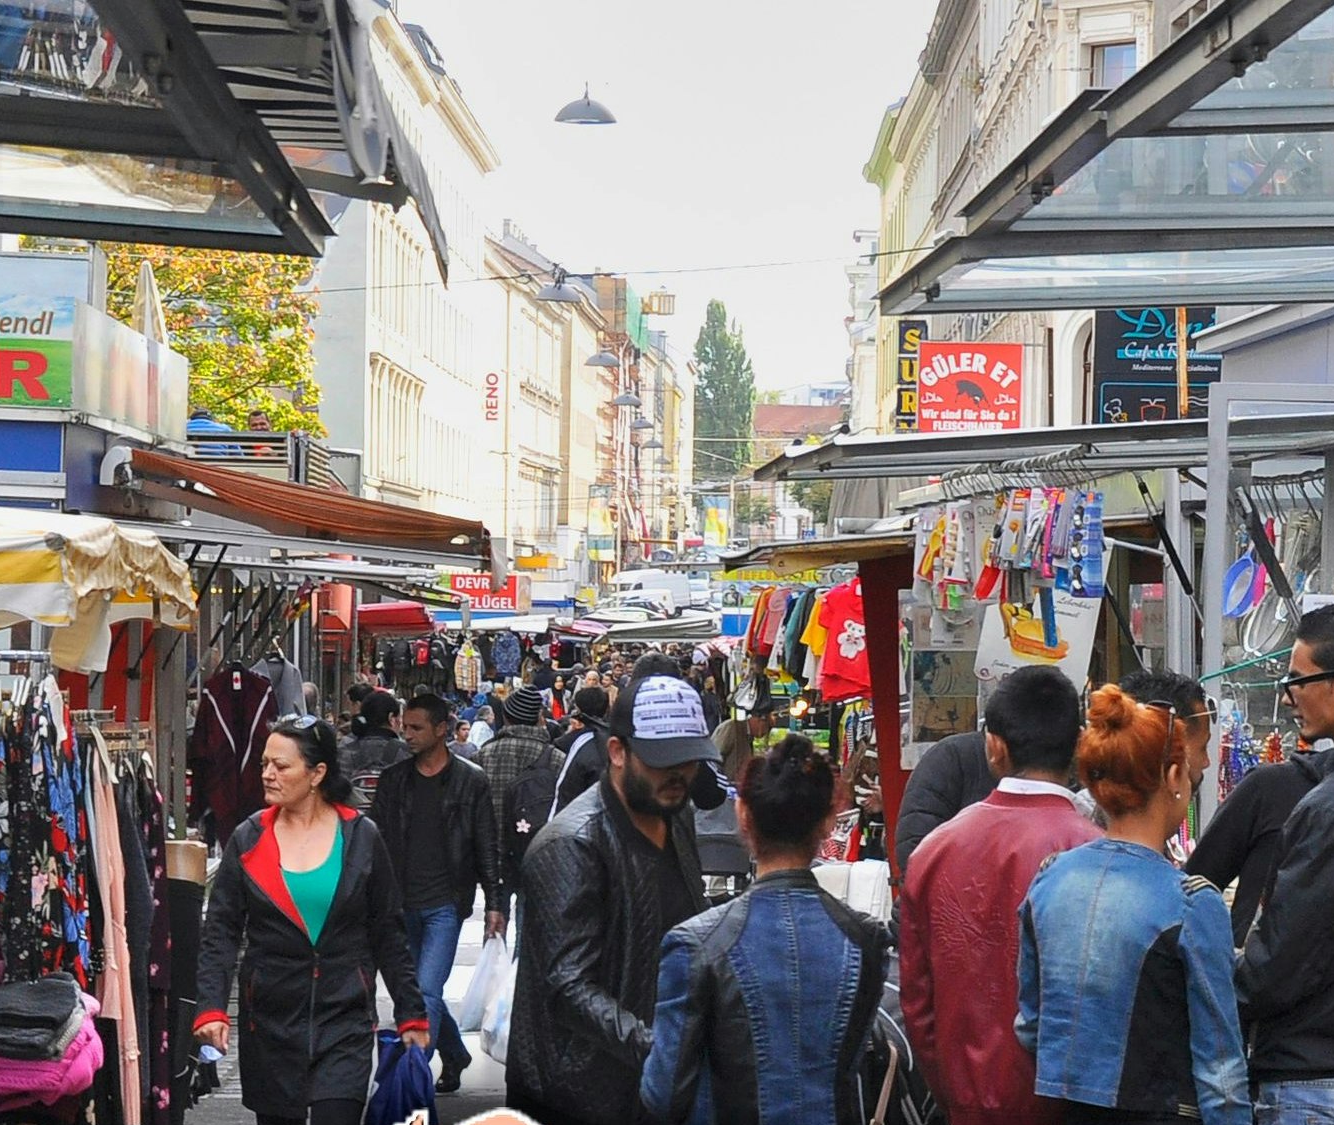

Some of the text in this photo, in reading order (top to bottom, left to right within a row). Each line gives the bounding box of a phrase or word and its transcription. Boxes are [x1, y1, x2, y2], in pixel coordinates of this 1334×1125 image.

[920, 352, 1019, 389] GÜLER ET
[485, 372, 499, 421] RENO
[921, 408, 939, 420] Wir
[940, 409, 962, 420] sind
[963, 408, 979, 420] für
[980, 409, 996, 421] Sie
